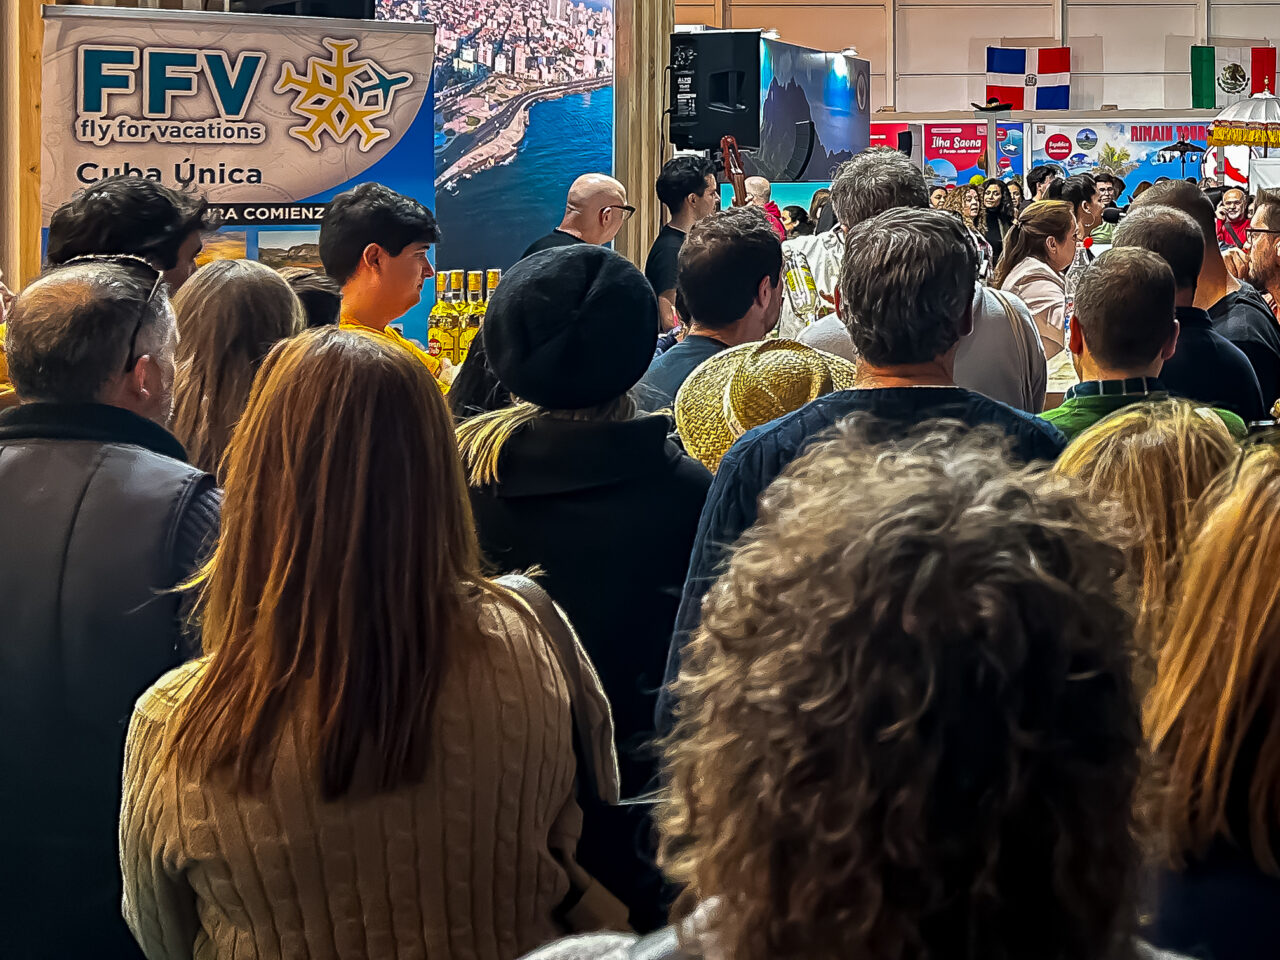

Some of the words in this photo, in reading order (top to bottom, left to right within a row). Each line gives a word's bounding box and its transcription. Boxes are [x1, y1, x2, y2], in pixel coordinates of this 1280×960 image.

[81, 47, 264, 118] FFV
[81, 119, 112, 141] fly
[117, 120, 150, 139] for
[156, 121, 262, 139] vacations
[1176, 125, 1209, 142] TOUR
[931, 136, 950, 148] Ilha
[953, 136, 982, 149] Saona
[76, 162, 161, 184] Cuba
[174, 157, 262, 184] Única
[243, 207, 326, 221] COMIENZ
